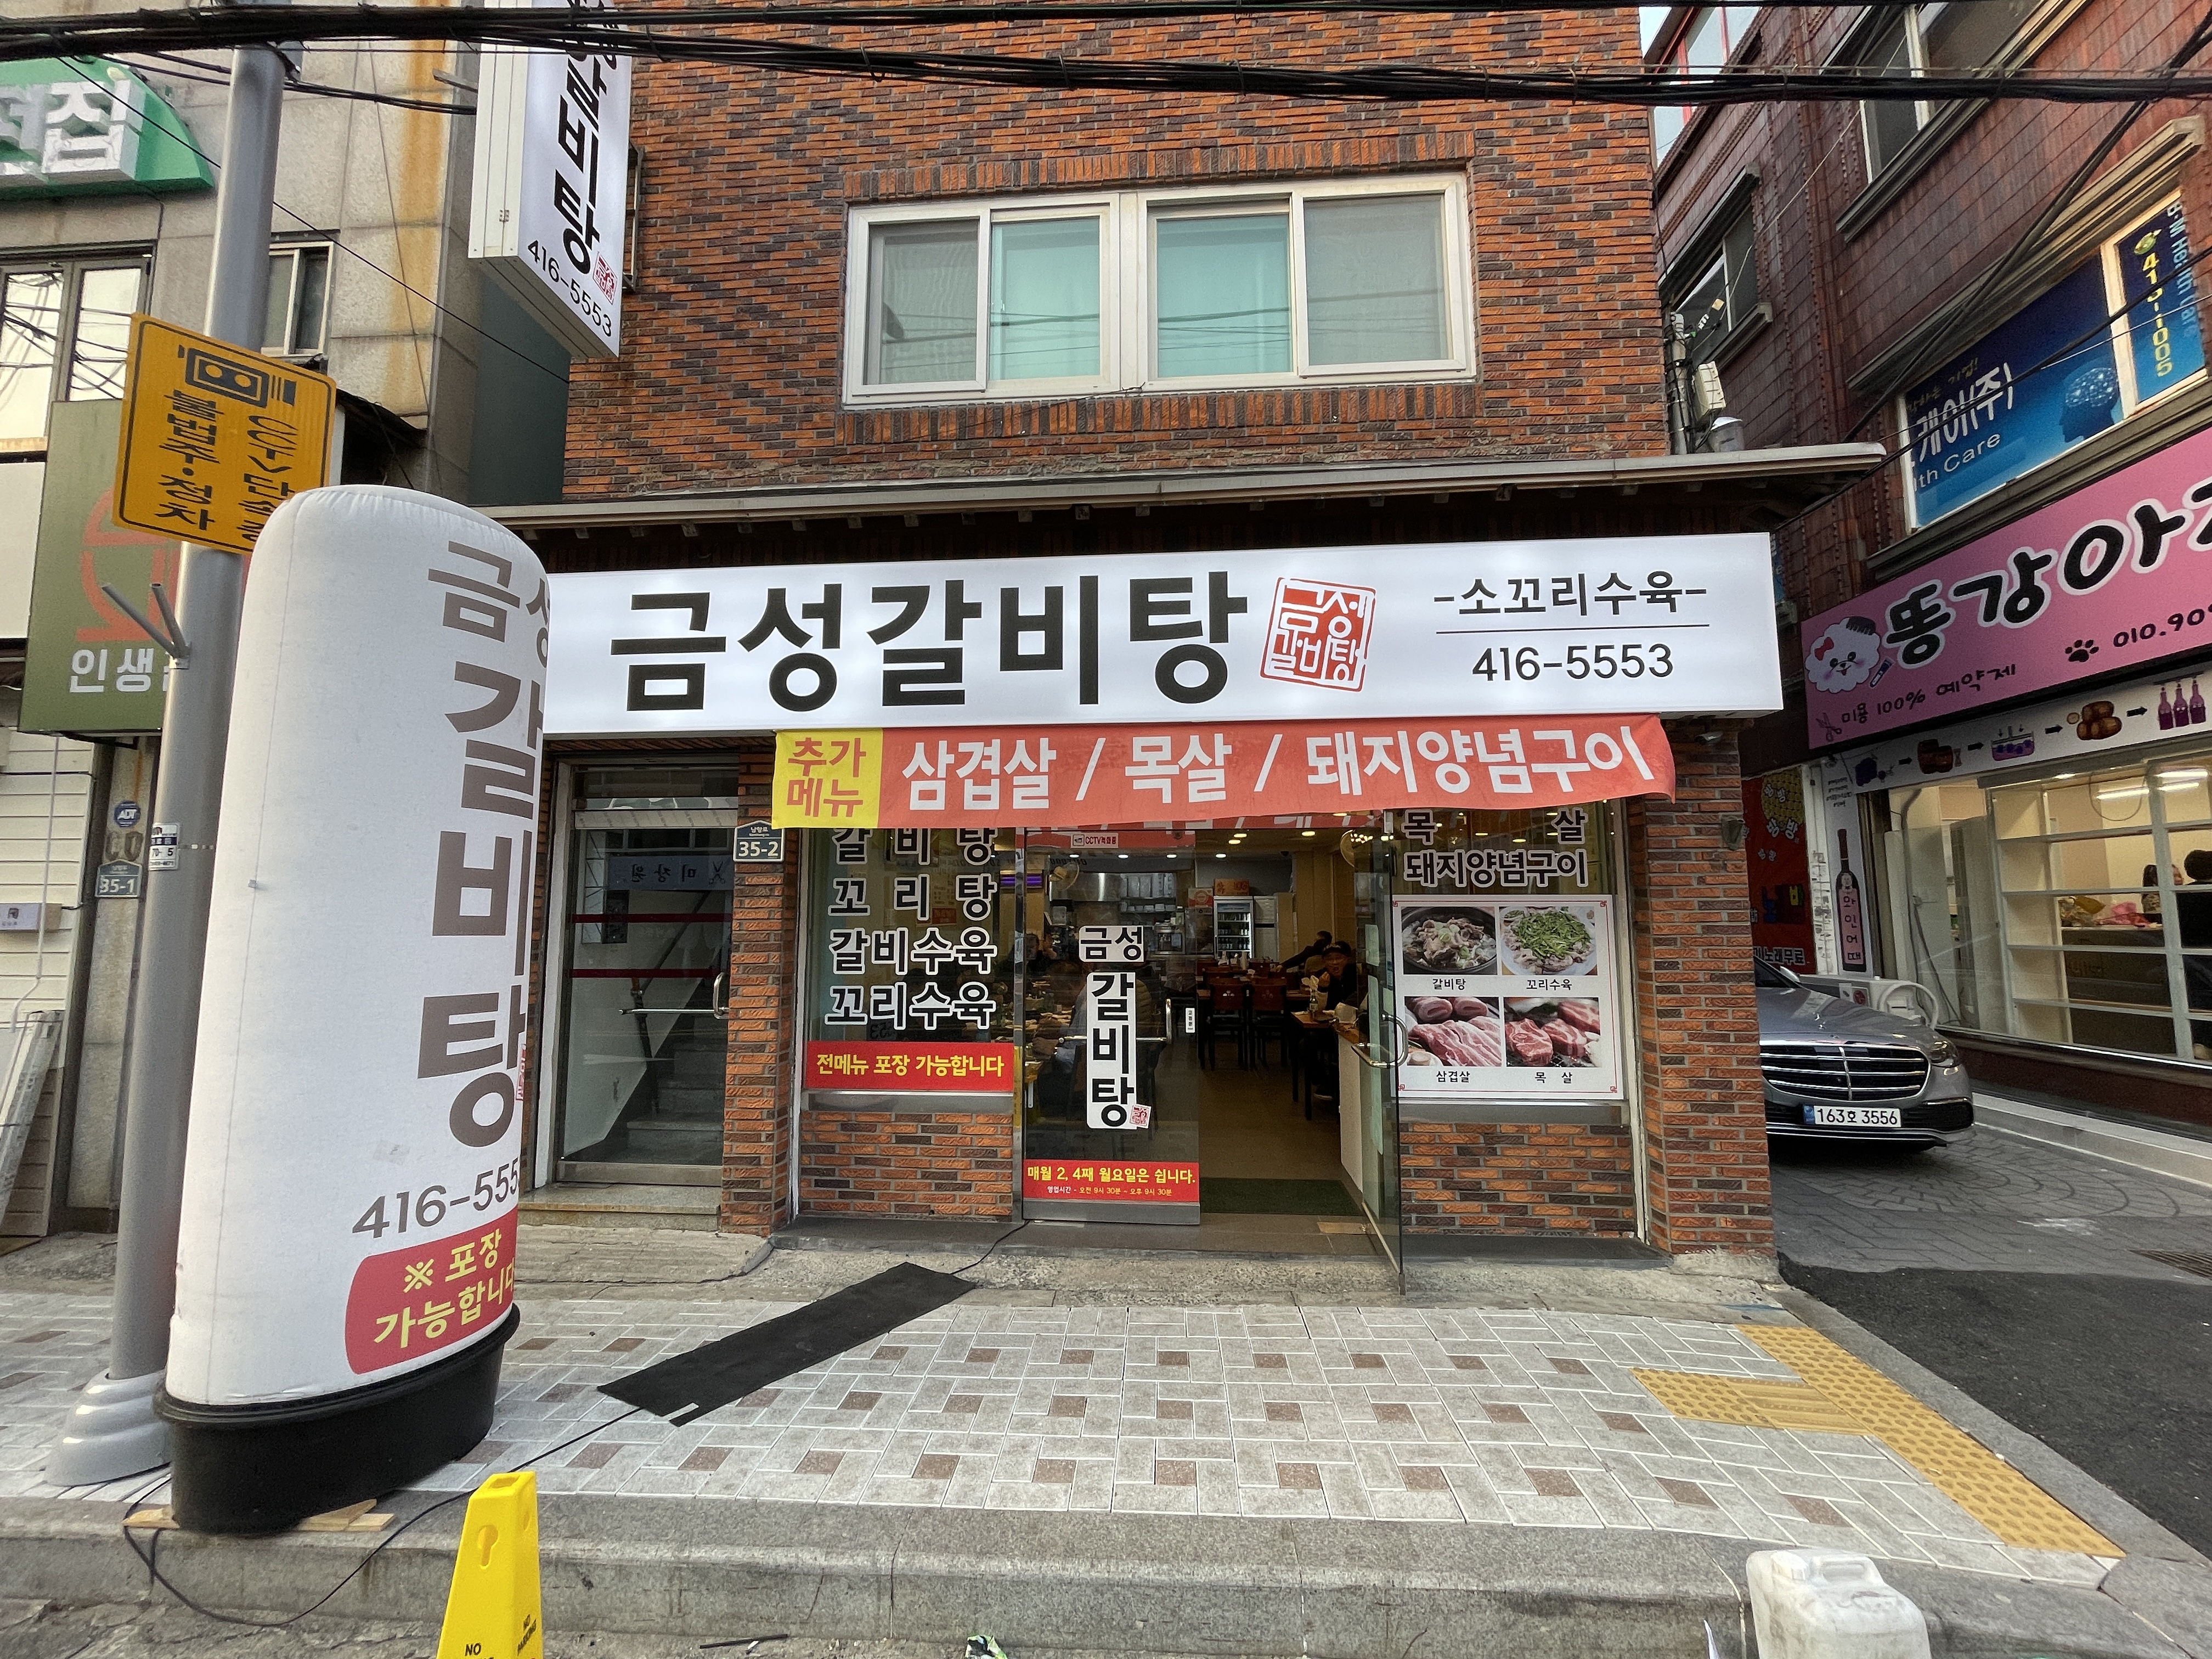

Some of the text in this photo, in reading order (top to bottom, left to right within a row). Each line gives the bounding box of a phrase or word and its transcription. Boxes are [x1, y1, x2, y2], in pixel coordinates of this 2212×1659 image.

[528, 240, 612, 337] 416-5553
[1944, 434, 2001, 472] Care
[611, 571, 1248, 712] 금성갈비탕
[2113, 603, 2212, 647] 010.90
[70, 648, 167, 692] 인생
[1472, 644, 1674, 681] 416-5553
[1842, 664, 2016, 724] 미용 100% 예약제
[788, 737, 866, 778] 추가
[902, 737, 1057, 810] 삼겹살
[1125, 733, 1232, 804] 목살
[1306, 726, 1654, 795] 돼지양념구이
[117, 809, 137, 820] ADT
[787, 778, 864, 817] 메뉴
[738, 841, 778, 857] 35-2
[1403, 849, 1589, 887] 돼지양념구이
[99, 878, 135, 895] 35-1
[829, 927, 997, 975] 갈비수육
[1081, 927, 1143, 961] 금성
[1432, 978, 1466, 990] 갈비탕
[1526, 978, 1572, 991] 꼬리수육
[825, 981, 997, 1030] 꼬리수육
[816, 1054, 1005, 1077] 전메뉴 포장 가능합니다
[1091, 973, 1135, 1127] 갈비탕
[1436, 1070, 1470, 1084] 삼겹살
[1817, 1108, 1857, 1123] 163호
[1861, 1110, 1897, 1125] 3556
[1027, 1166, 1052, 1182] 매월
[1057, 1166, 1069, 1182] 2,
[1072, 1166, 1094, 1182] 4째
[1099, 1167, 1150, 1183] 월요일은
[1047, 1186, 1071, 1194] 영업시간
[1144, 1188, 1155, 1196] 9시
[445, 1228, 502, 1282] 포장
[465, 1643, 482, 1657] NO
